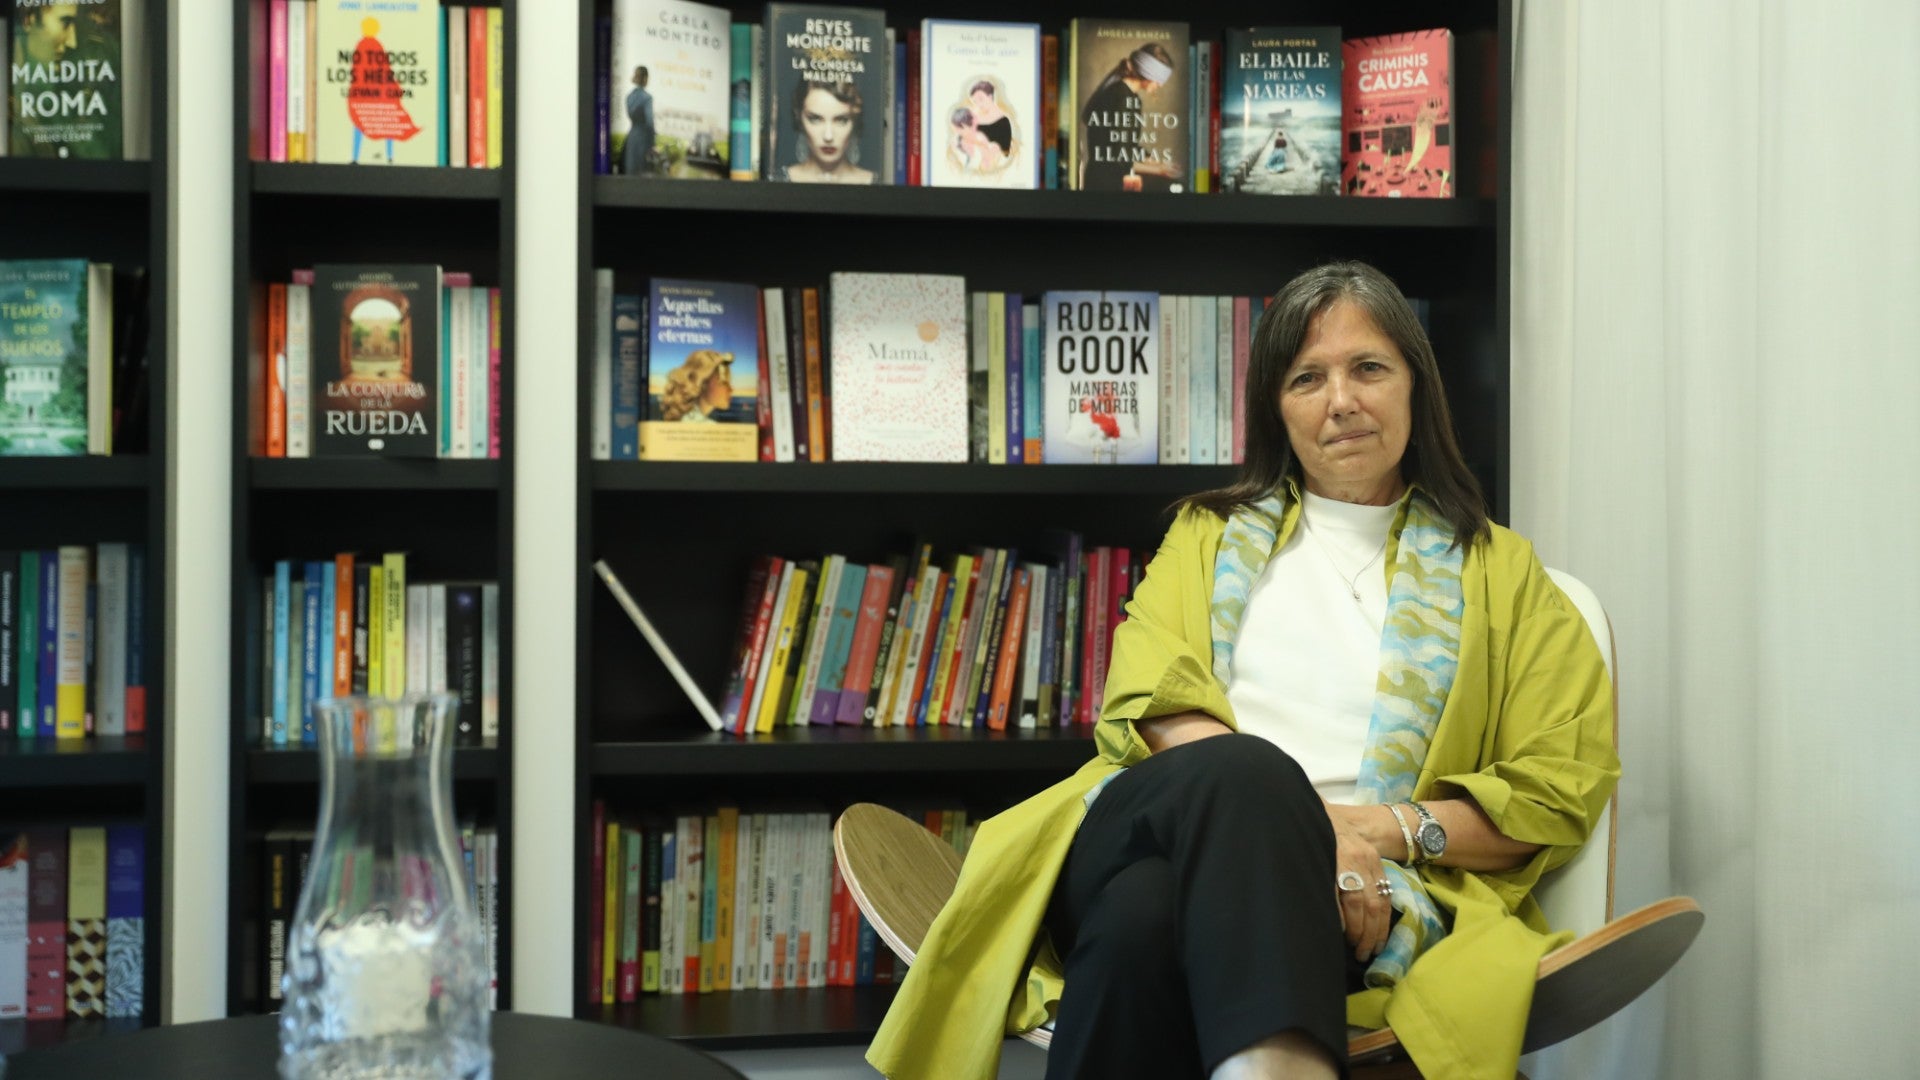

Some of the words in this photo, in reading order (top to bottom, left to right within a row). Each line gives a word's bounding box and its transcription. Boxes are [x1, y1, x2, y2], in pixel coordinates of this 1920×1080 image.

[659, 9, 710, 32] CARLA
[806, 18, 853, 36] REYES
[646, 26, 721, 50] MONTERO
[786, 33, 872, 53] MONFORTE
[1252, 40, 1281, 48] LAURA
[1283, 38, 1317, 48] PORTAS
[338, 50, 362, 64] NO
[367, 51, 418, 66] TODOS
[791, 56, 807, 70] LA
[810, 58, 865, 73] CONDESA
[1240, 52, 1266, 69] EL
[1270, 51, 1331, 69] BAILE
[1358, 52, 1429, 74] CRIMINIS
[12, 59, 116, 85] MALDITA
[327, 67, 357, 84] LOS
[364, 66, 428, 85] HÉROES
[803, 70, 854, 84] MALDITA
[1263, 70, 1280, 81] DE
[1283, 70, 1306, 81] LAS
[1358, 69, 1430, 93] CAUSA
[1243, 83, 1327, 99] MAREAS
[21, 90, 107, 117] ROMA
[1125, 97, 1141, 110] EL
[1087, 111, 1179, 130] ALIENTO
[1110, 131, 1128, 144] DE
[1131, 131, 1157, 144] LAS
[1094, 147, 1173, 163] LLAMAS
[1, 302, 64, 320] TEMPLO
[658, 296, 724, 317] Aquellas
[658, 313, 712, 329] noches
[1057, 301, 1150, 332] ROBIN
[657, 329, 714, 344] eternas
[867, 340, 935, 365] Mamá,
[1057, 335, 1150, 375] COOK
[327, 382, 350, 397] LA
[350, 381, 428, 400] CONJURA
[1070, 381, 1137, 396] MANERAS
[1069, 398, 1087, 414] DE
[1091, 398, 1139, 414] MORIR
[325, 410, 429, 436] RUEDA
